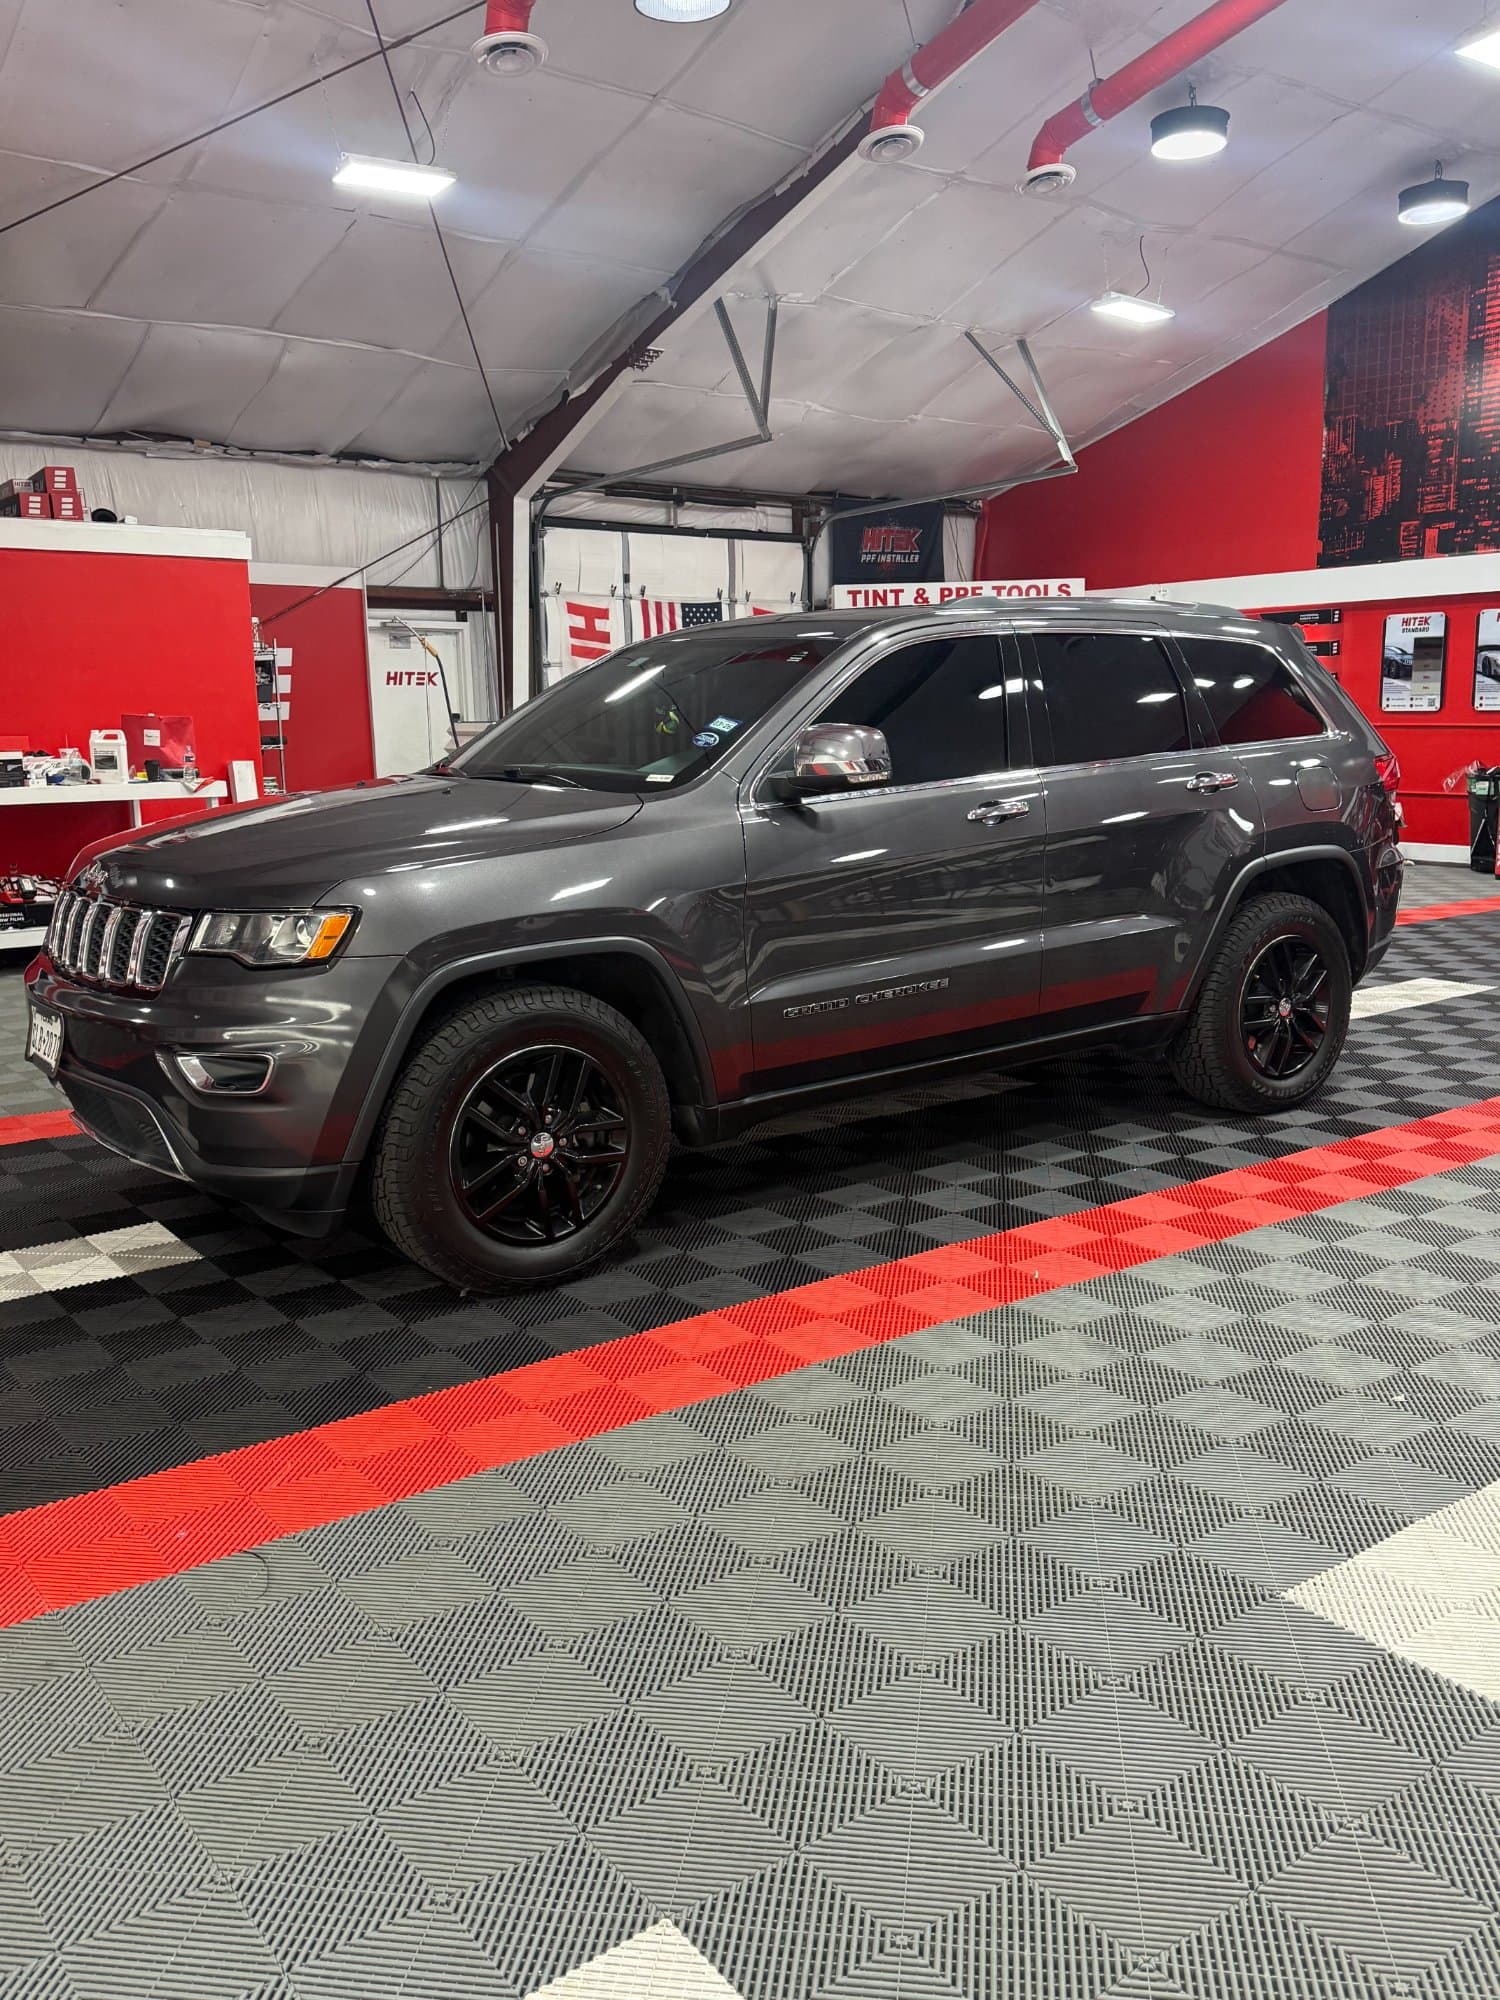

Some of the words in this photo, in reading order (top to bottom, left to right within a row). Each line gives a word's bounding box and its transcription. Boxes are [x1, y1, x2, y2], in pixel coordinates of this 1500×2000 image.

[862, 527, 922, 552] HITEK
[861, 554, 877, 562] PPF
[847, 588, 905, 607] TINT
[913, 587, 930, 606] &
[1402, 616, 1431, 627] HITEK
[386, 671, 439, 686] HITEK
[784, 997, 849, 1019] GRAND
[855, 977, 950, 1005] CHEROKEE
